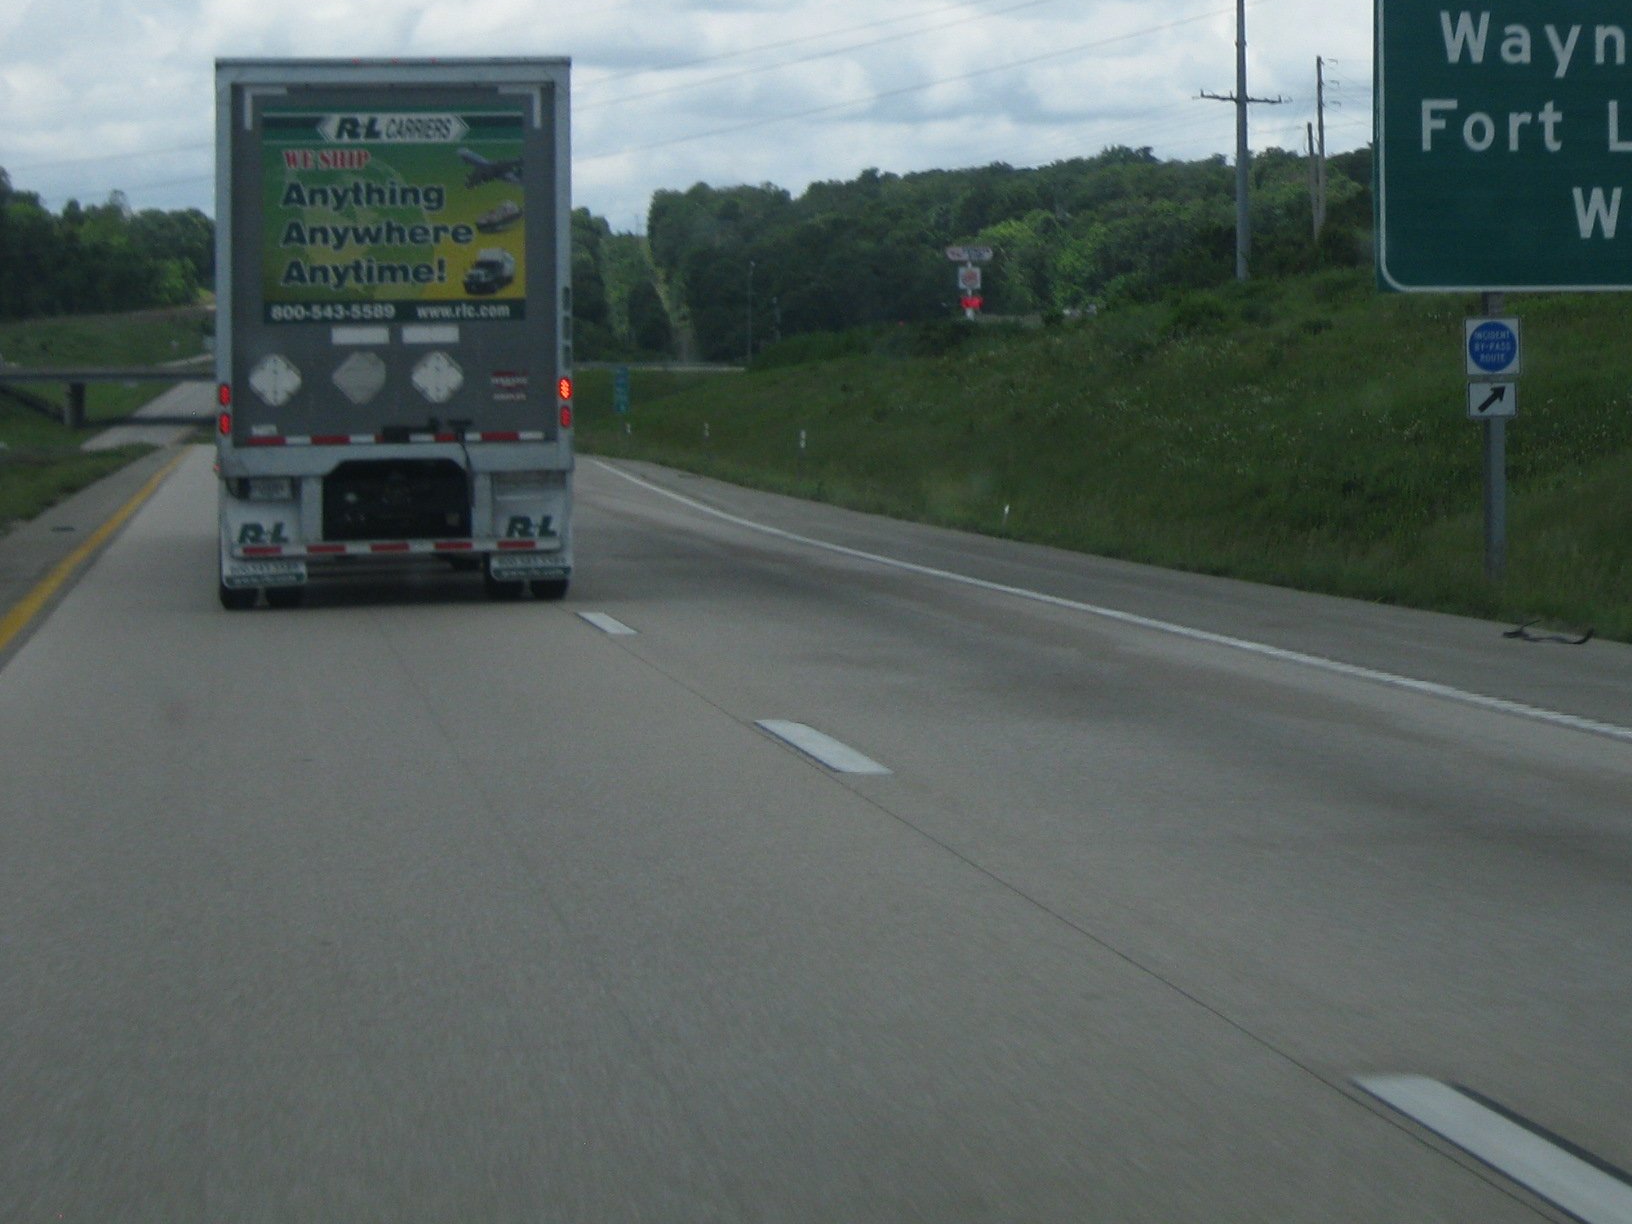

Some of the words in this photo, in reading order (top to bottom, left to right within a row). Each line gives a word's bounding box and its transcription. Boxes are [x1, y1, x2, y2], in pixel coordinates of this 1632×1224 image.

[386, 117, 452, 139] CARRIERS
[1421, 98, 1563, 152] Fort
[283, 149, 314, 170] WE
[319, 149, 370, 170] SHIP
[281, 179, 445, 212] Anything
[281, 219, 474, 252] Anywhere
[281, 256, 448, 291] Anytime!
[270, 303, 396, 321] 800-543-5589
[416, 303, 511, 319] www.rlc.com
